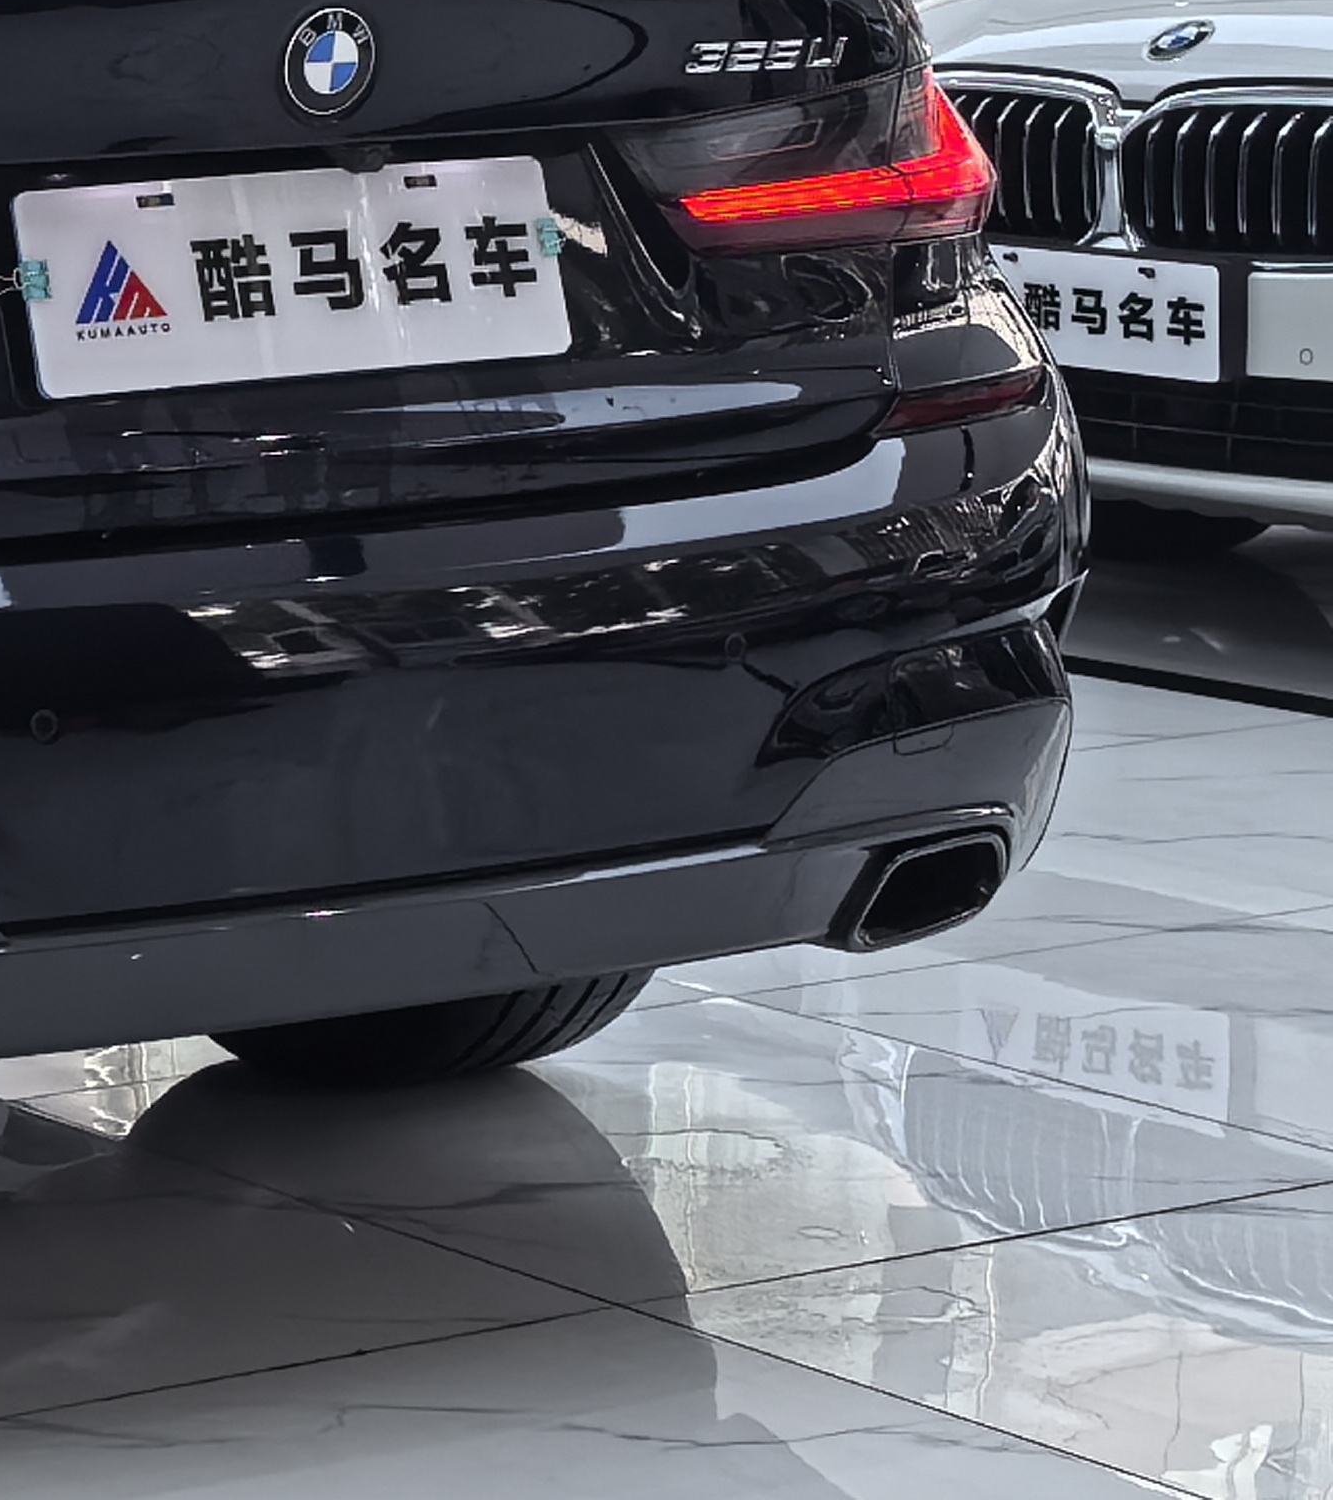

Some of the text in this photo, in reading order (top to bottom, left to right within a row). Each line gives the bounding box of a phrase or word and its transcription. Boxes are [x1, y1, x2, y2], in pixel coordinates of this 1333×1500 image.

[299, 11, 371, 47] BMW
[189, 215, 538, 322] 酷马名车
[76, 322, 172, 341] KUMAAUTO
[1023, 282, 1206, 345] 酷马名车
